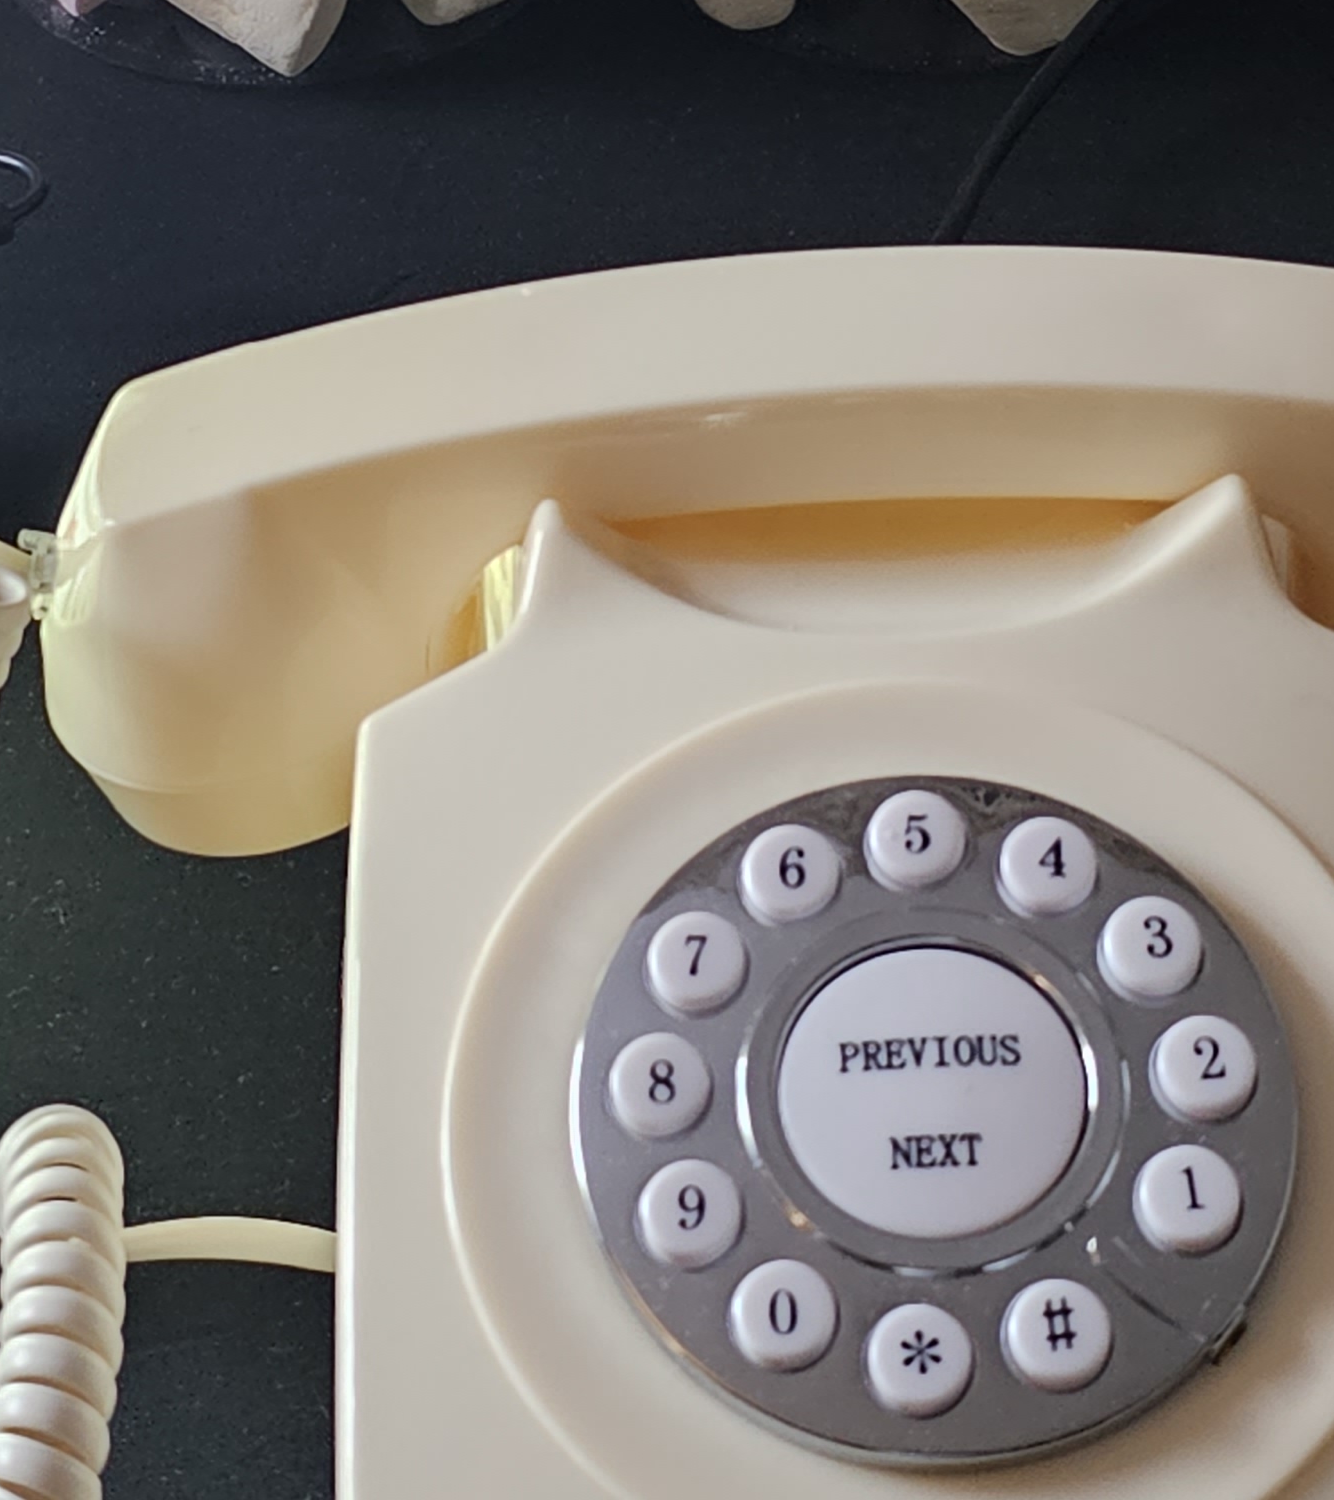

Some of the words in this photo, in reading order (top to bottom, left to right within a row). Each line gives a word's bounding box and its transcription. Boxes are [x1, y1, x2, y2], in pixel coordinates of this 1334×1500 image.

[905, 815, 931, 853] 5
[779, 847, 806, 889] 6
[1038, 837, 1067, 878] 4
[683, 934, 708, 977] 7
[1143, 916, 1174, 958] 3
[838, 1034, 1022, 1072] PREVIOUS
[1193, 1037, 1226, 1081] 2
[648, 1059, 676, 1103] 8
[889, 1133, 982, 1170] NEXT
[678, 1185, 706, 1231] 9
[1182, 1166, 1202, 1211] 1
[768, 1289, 798, 1334] 0
[1041, 1297, 1078, 1351] #
